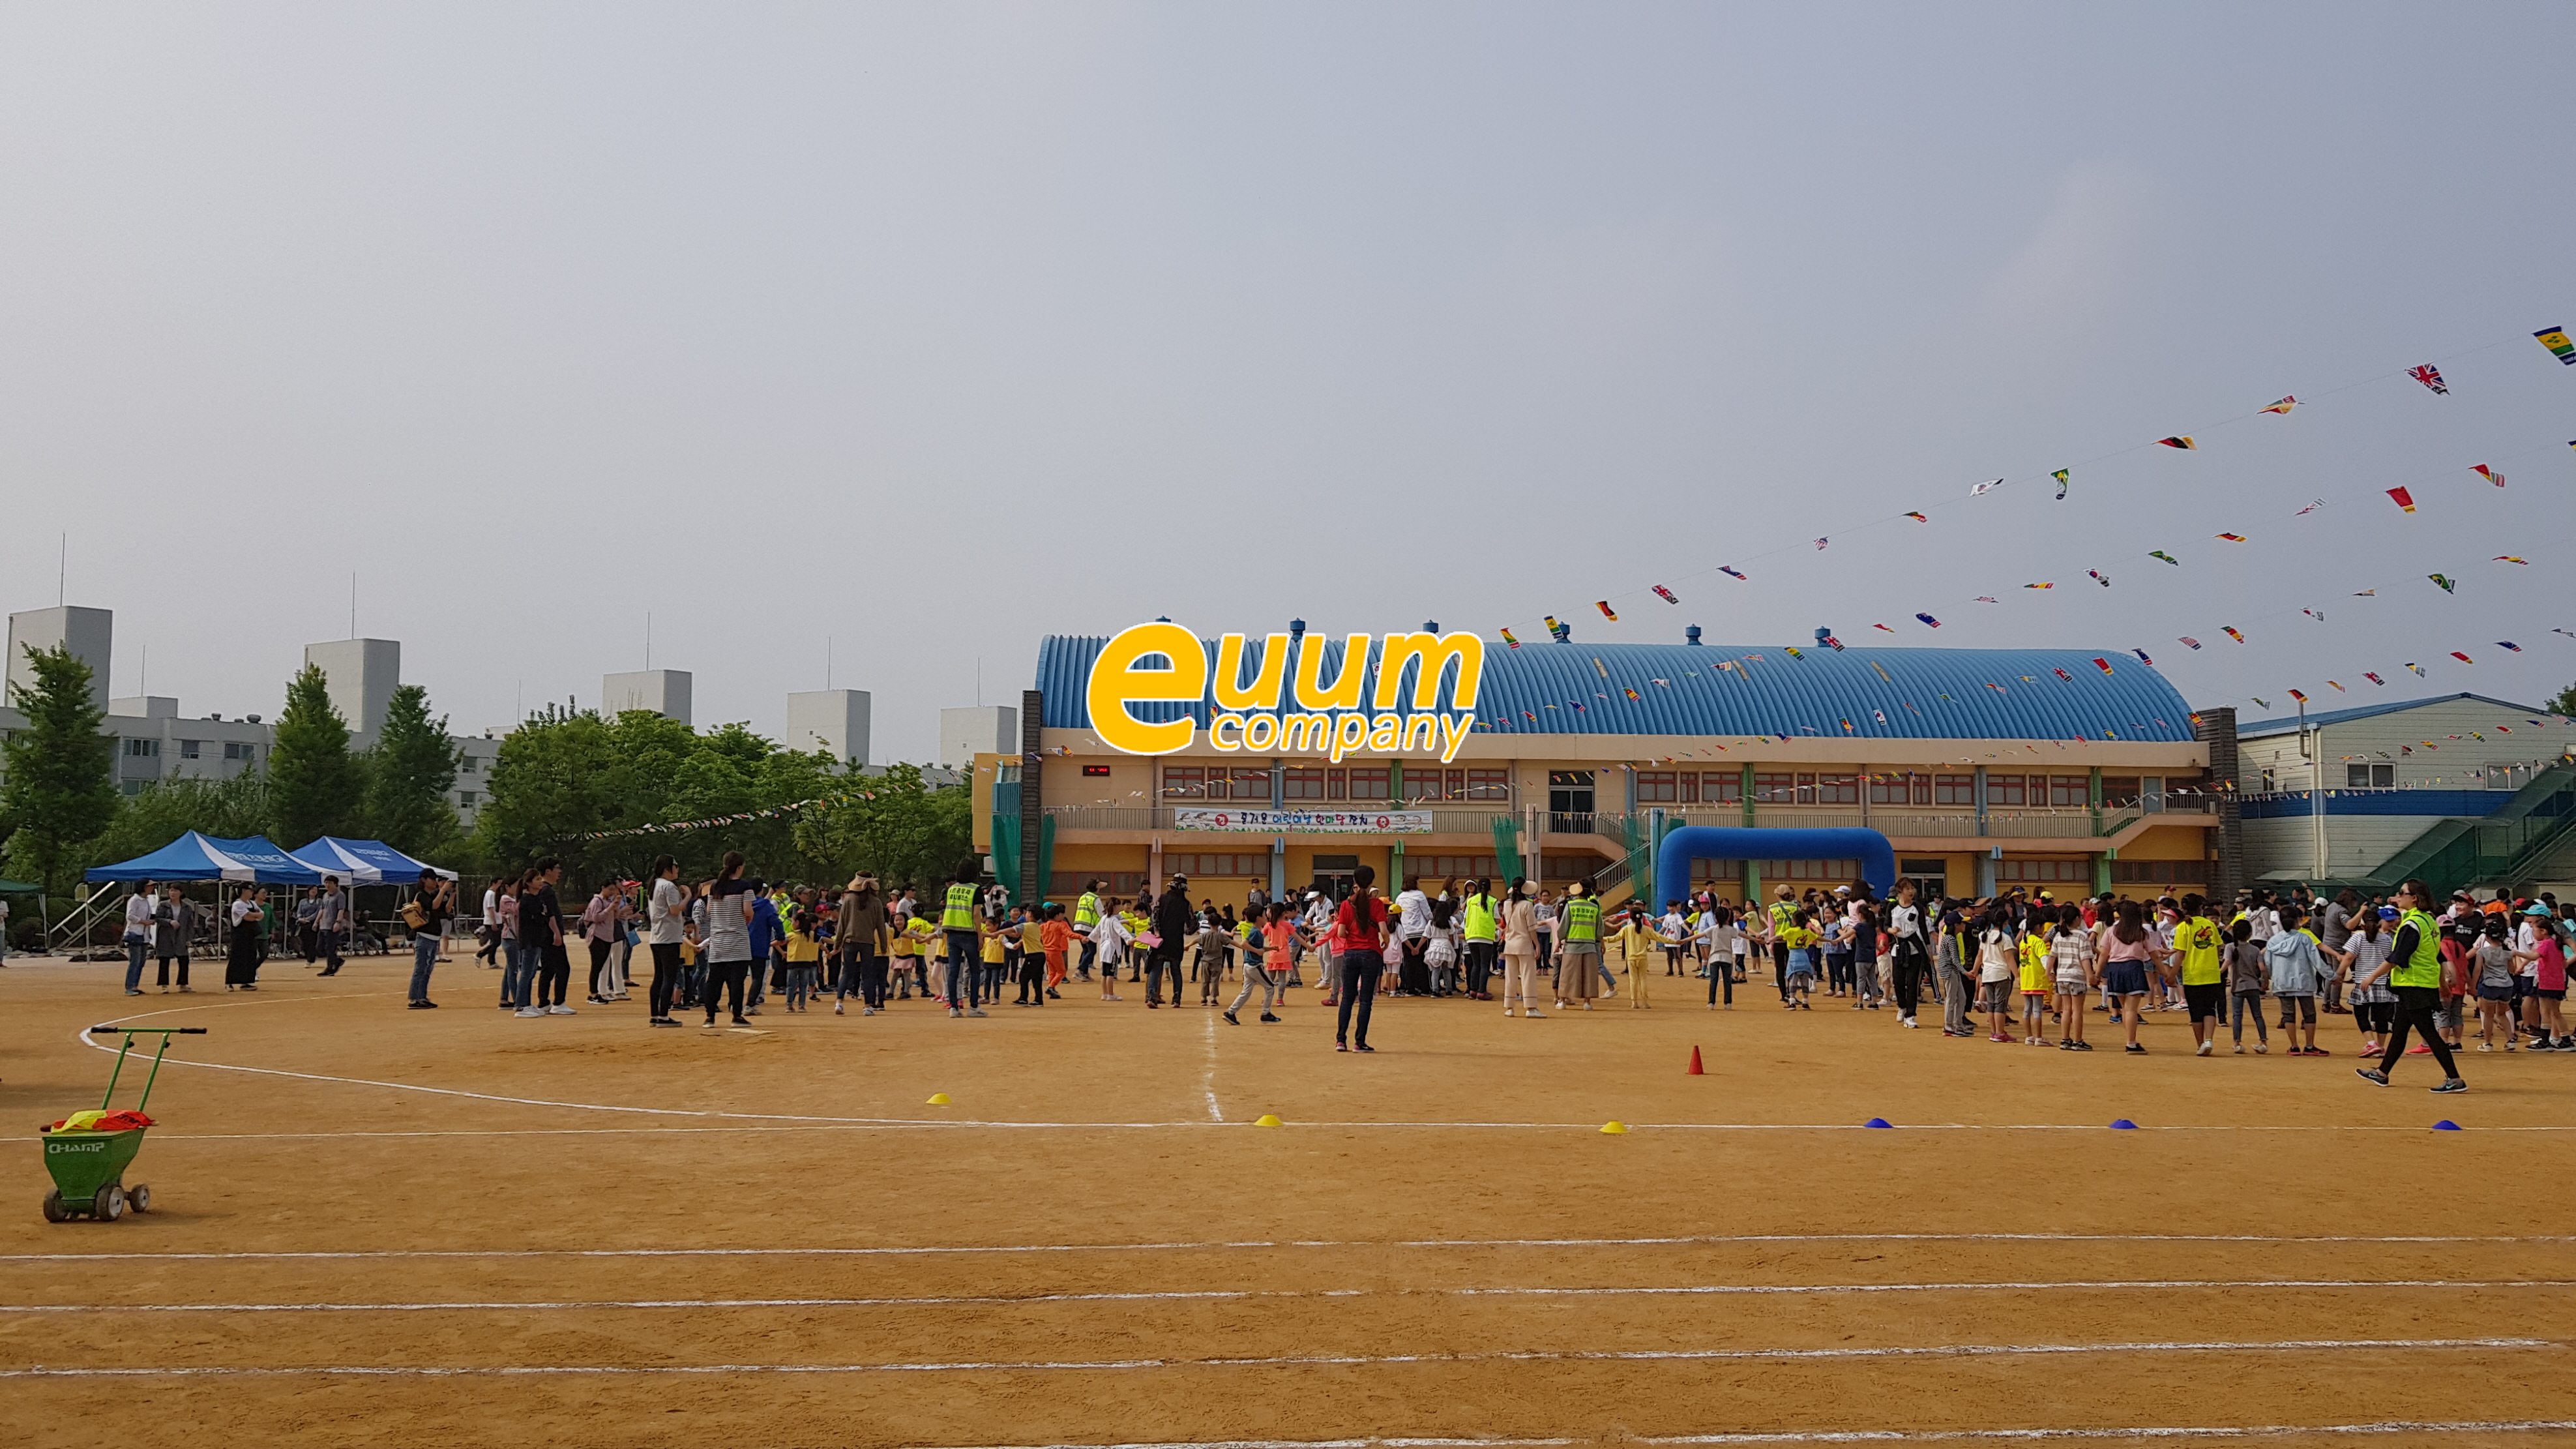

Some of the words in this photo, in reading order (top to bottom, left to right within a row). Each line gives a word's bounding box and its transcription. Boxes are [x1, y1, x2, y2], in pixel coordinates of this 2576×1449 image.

[1241, 812, 1267, 824] 즐거운
[1273, 813, 1311, 825] 어린이날
[1315, 814, 1345, 826] 한마당
[1349, 814, 1367, 826] 잔치
[48, 1143, 104, 1154] CHAMP
